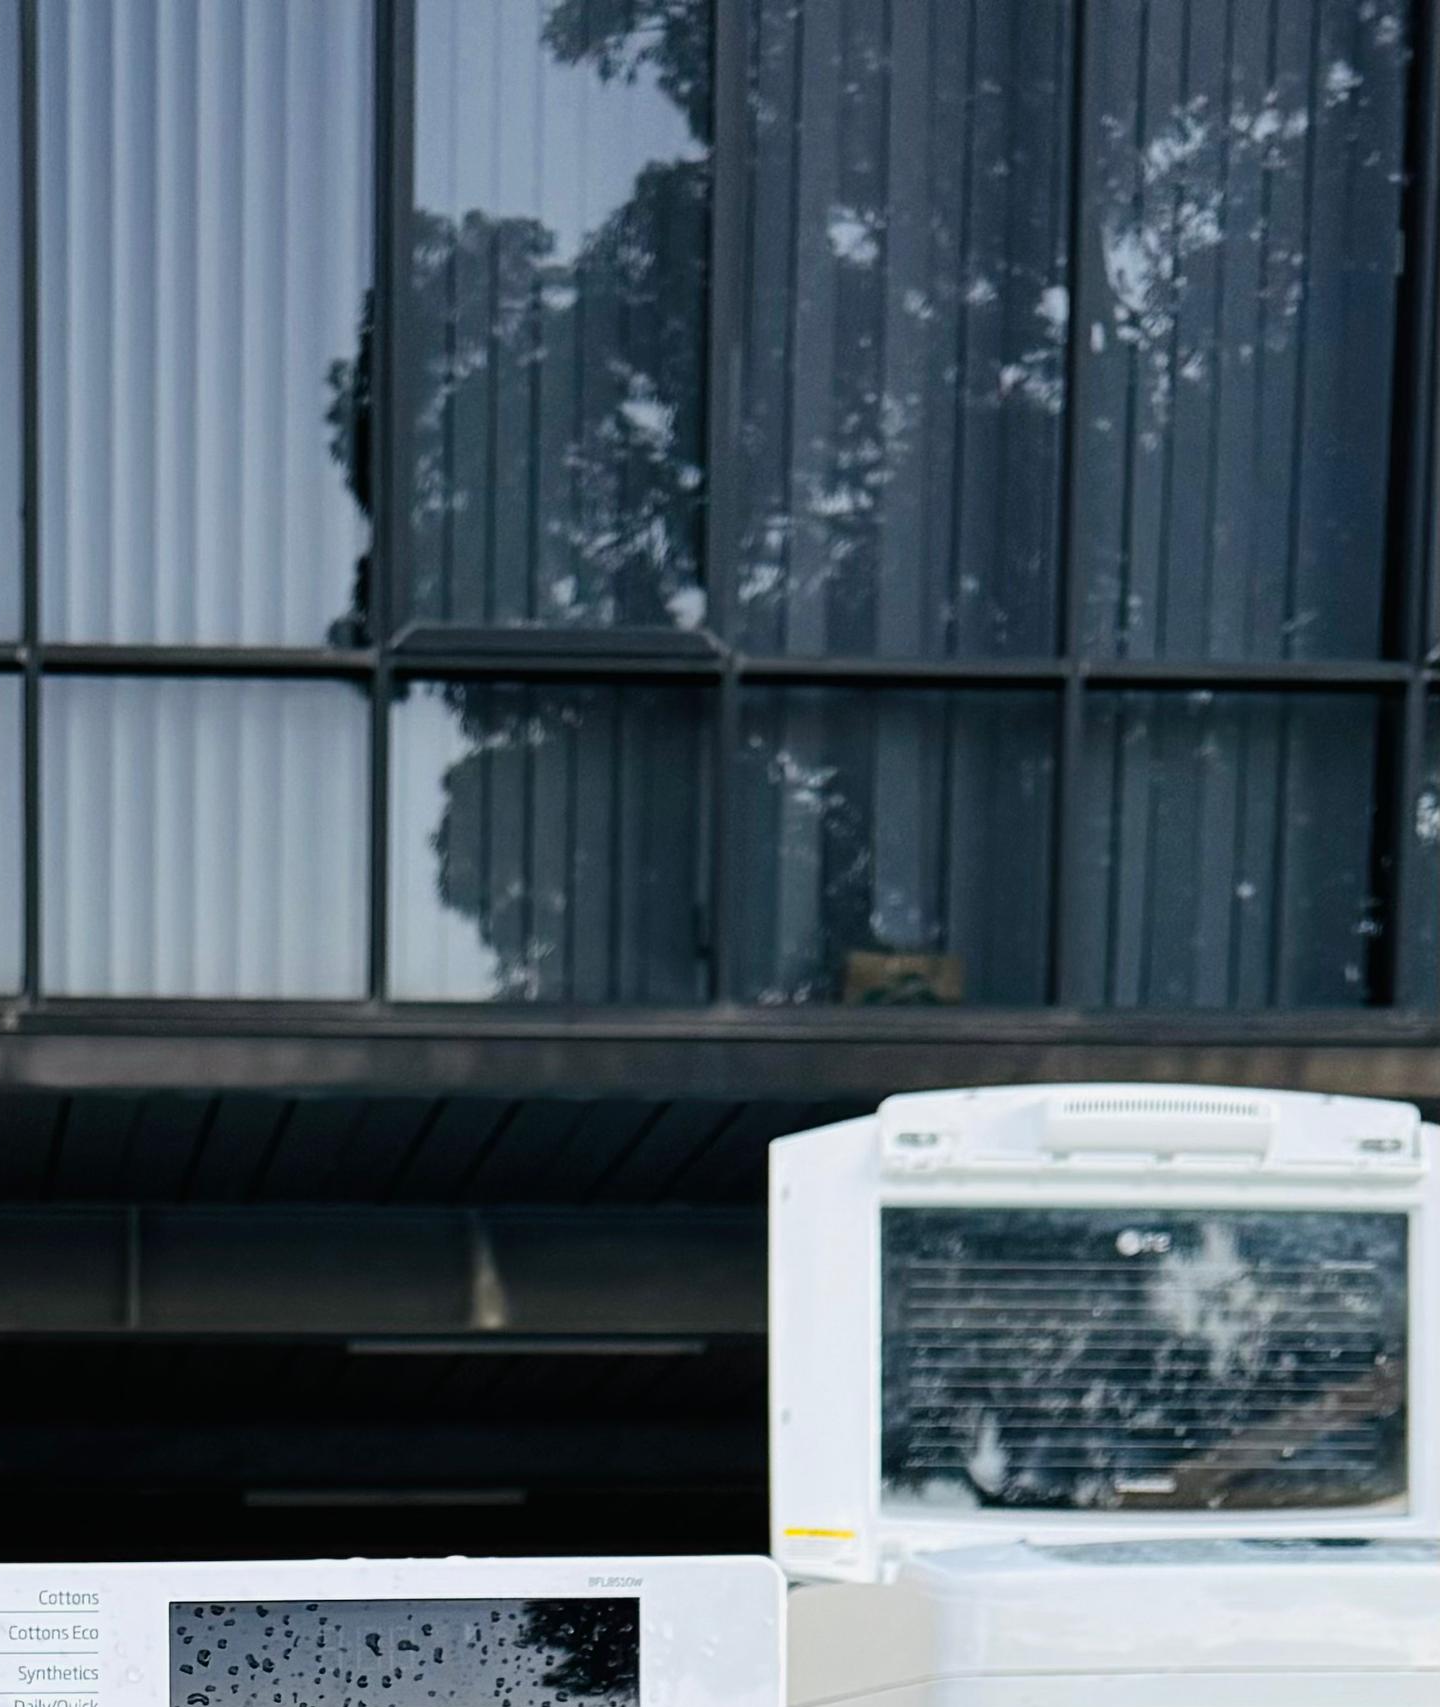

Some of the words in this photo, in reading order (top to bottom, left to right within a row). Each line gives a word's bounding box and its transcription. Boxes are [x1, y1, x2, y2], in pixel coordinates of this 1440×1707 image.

[38, 1589, 100, 1606] Cottons
[8, 1624, 70, 1641] Cottons
[72, 1624, 100, 1641] Eco
[17, 1665, 99, 1684] Synthetics
